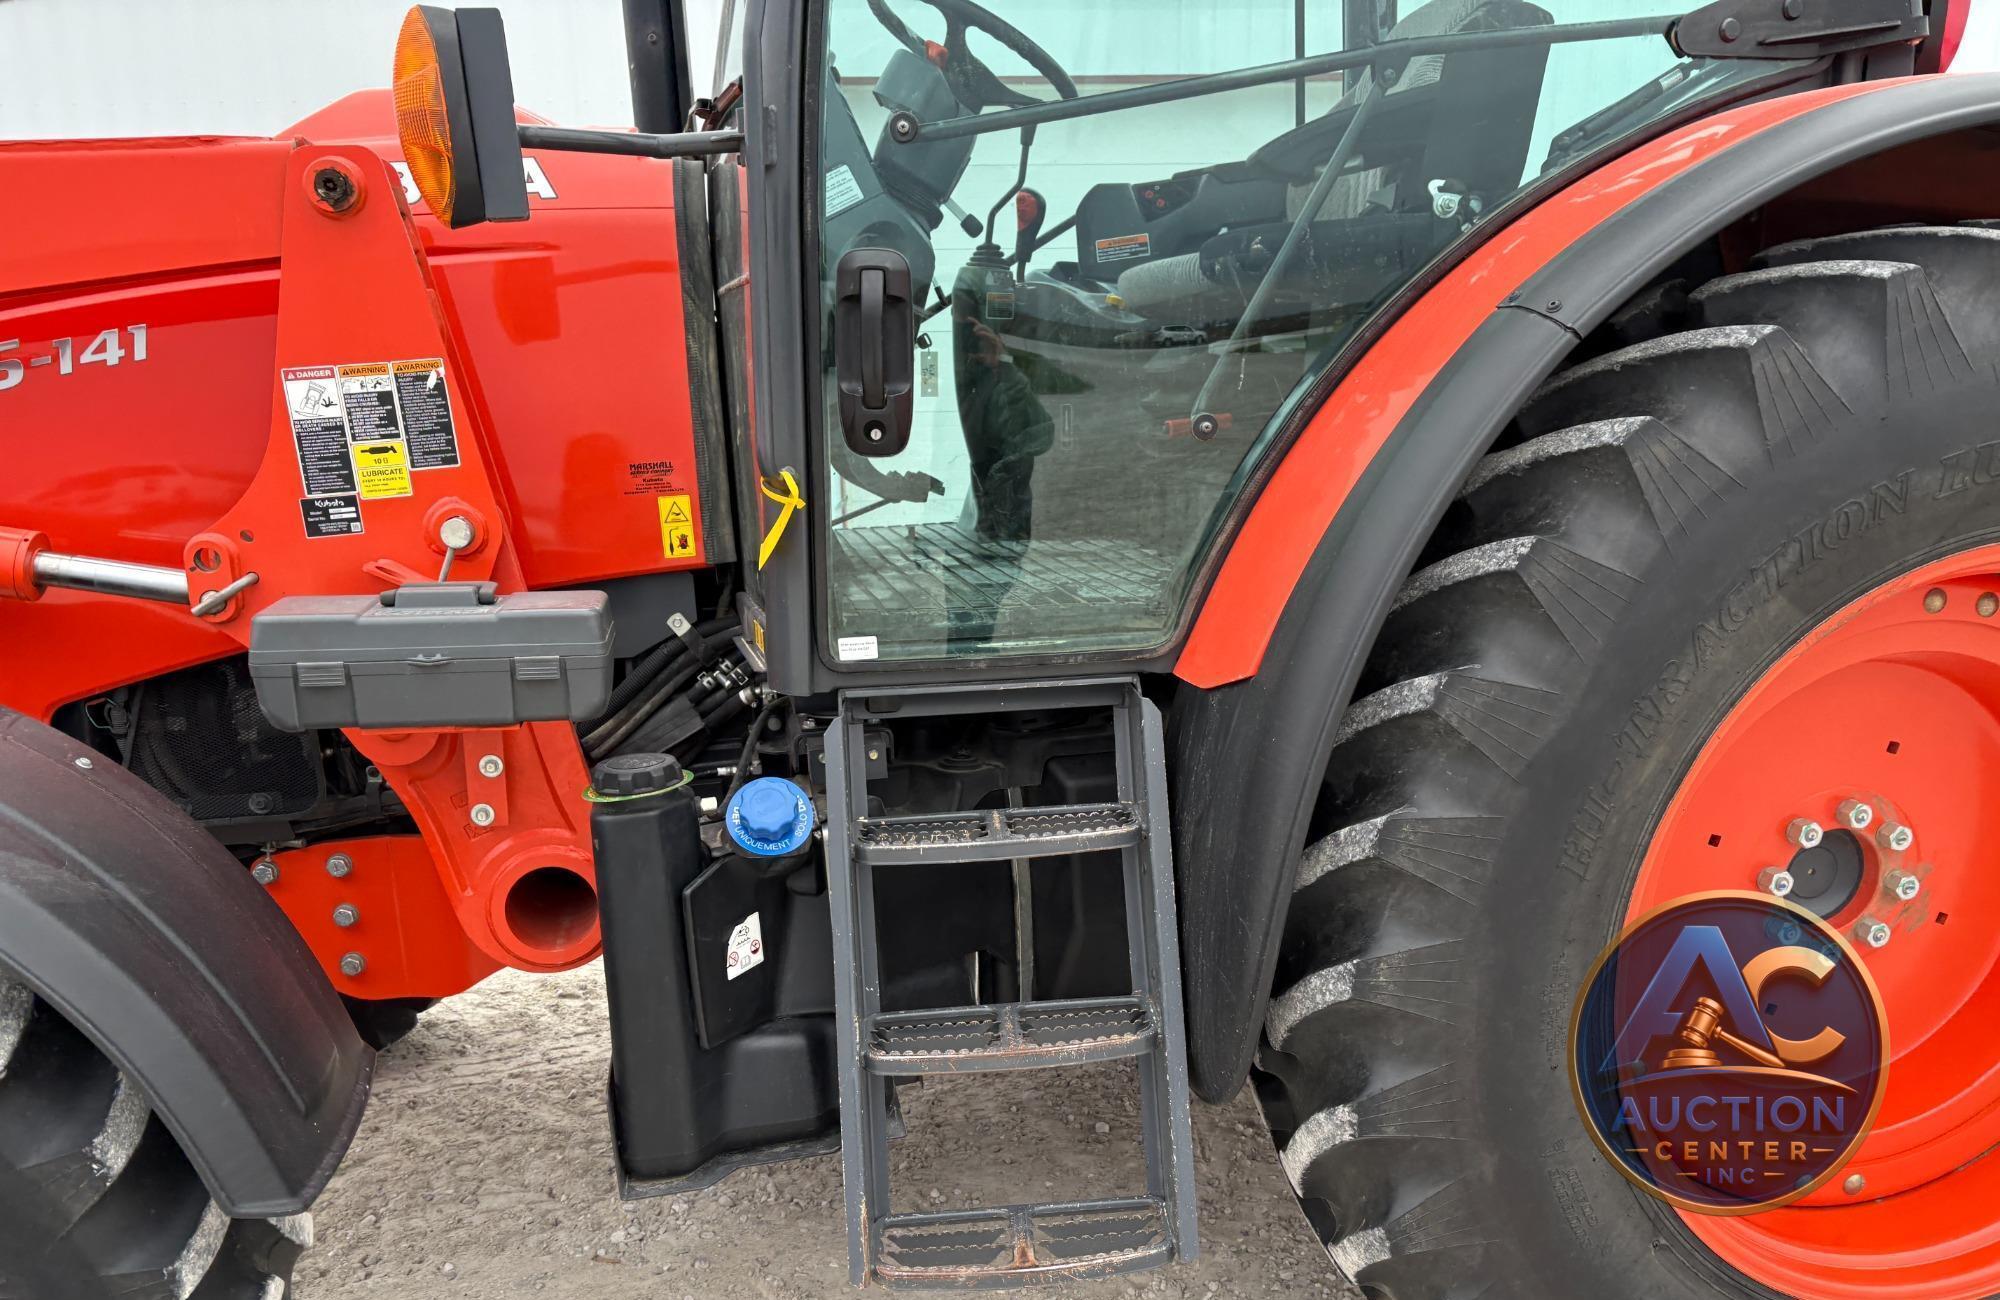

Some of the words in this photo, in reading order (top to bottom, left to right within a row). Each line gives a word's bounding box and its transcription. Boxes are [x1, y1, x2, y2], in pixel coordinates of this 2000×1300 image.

[349, 366, 387, 376] WARNING
[400, 361, 439, 371] WARNING
[296, 369, 332, 379] DANGER
[629, 461, 673, 470] MARSHALL
[362, 468, 404, 477] LUBRICATE
[315, 498, 344, 507] Kubota
[794, 815, 808, 837] SOLO
[735, 826, 791, 851] UNIQUEMENT
